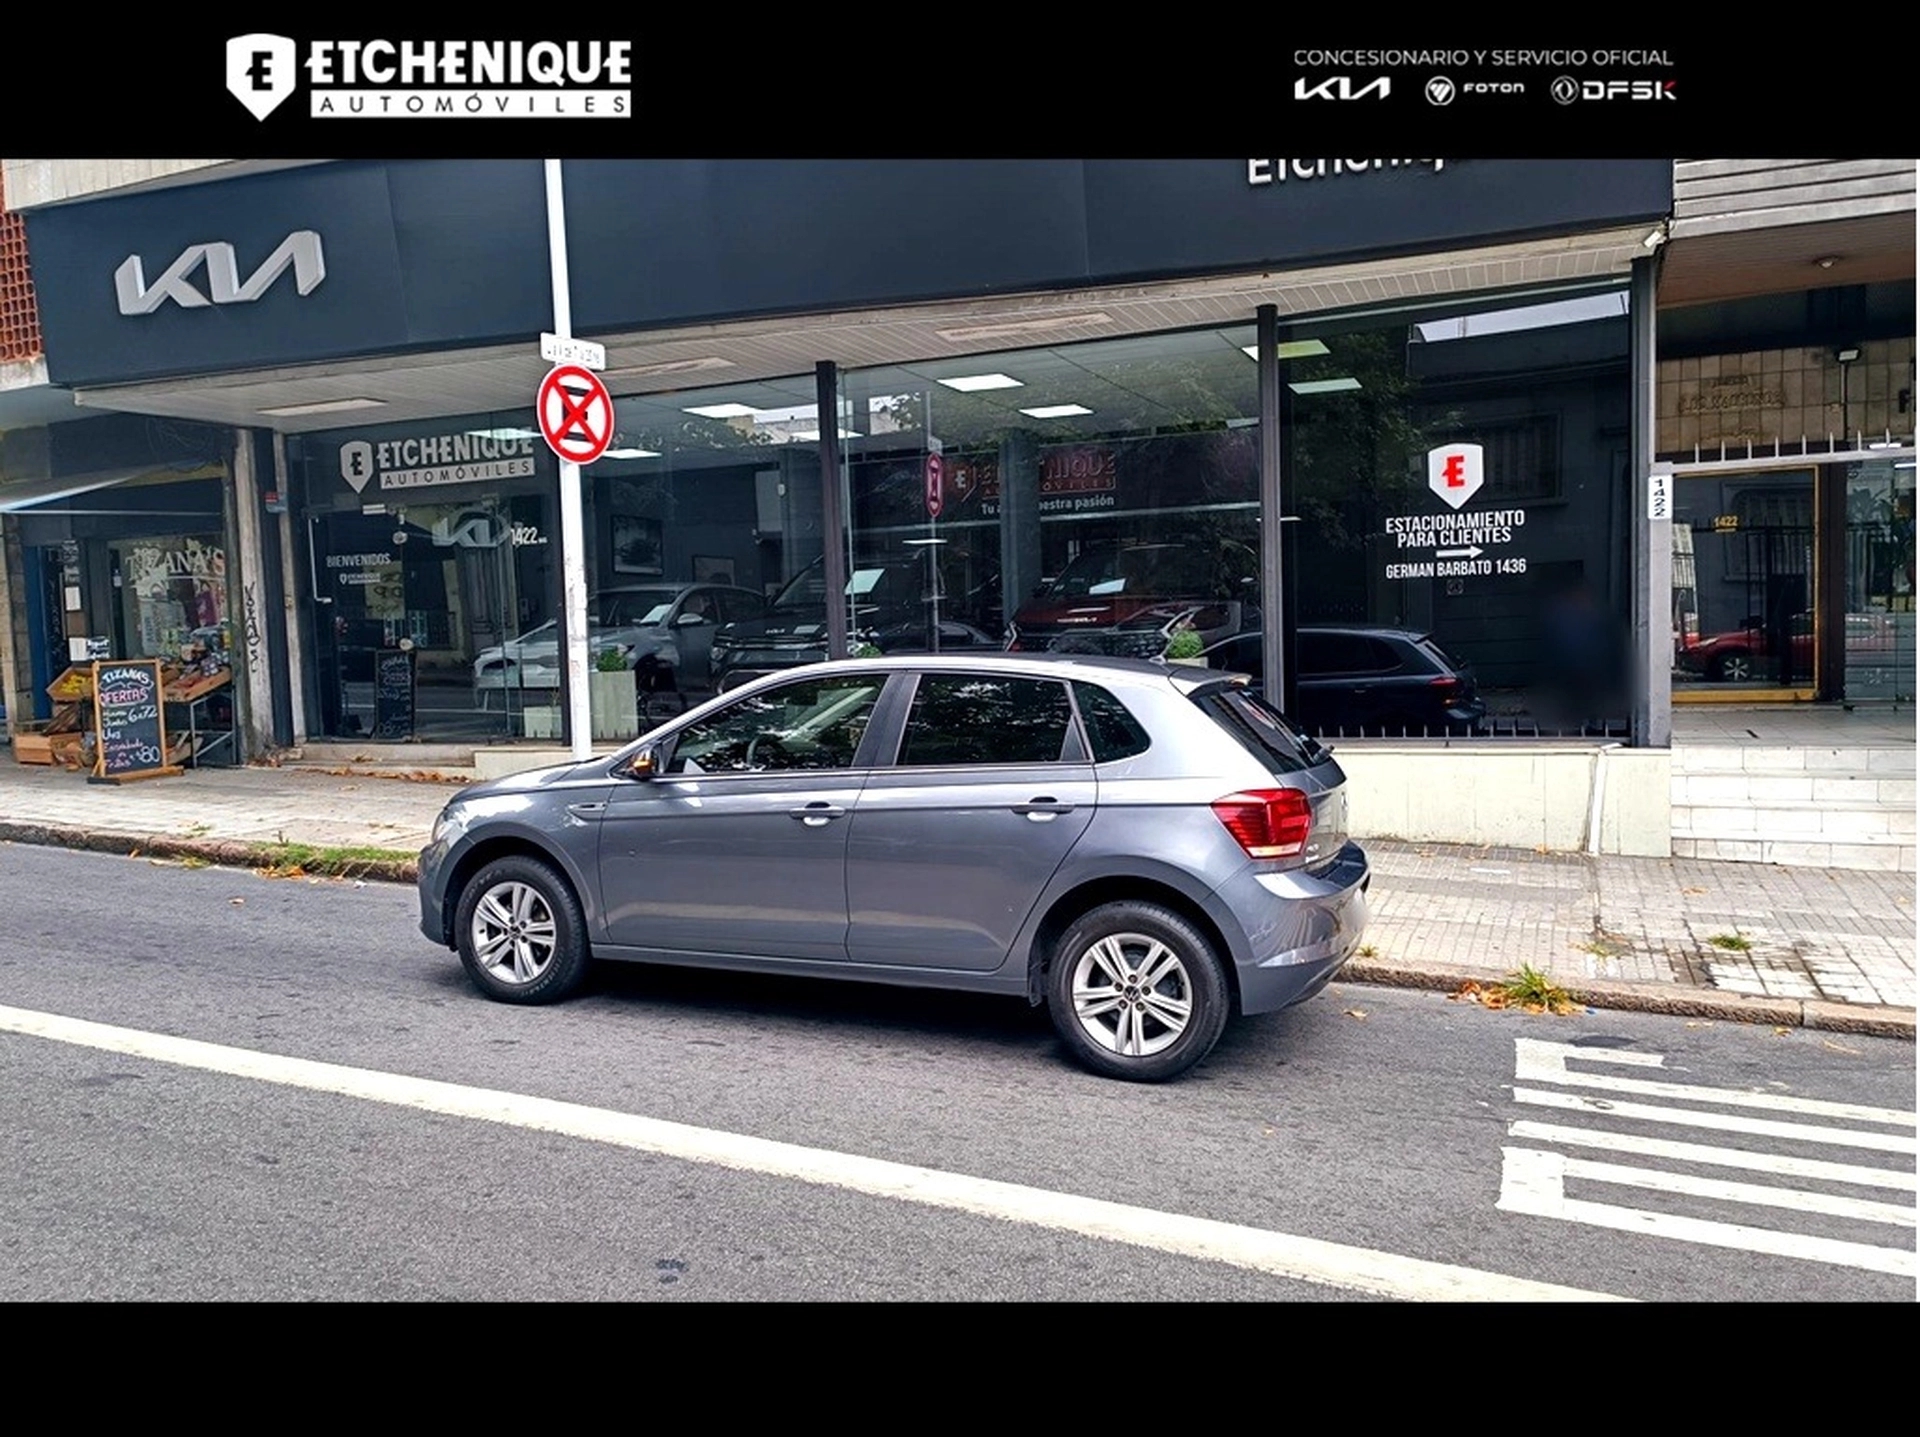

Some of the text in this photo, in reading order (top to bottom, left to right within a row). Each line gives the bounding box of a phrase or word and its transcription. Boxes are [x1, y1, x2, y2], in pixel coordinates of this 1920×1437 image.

[376, 427, 534, 469] ETCHENIQUE
[1442, 455, 1465, 488] E
[981, 503, 996, 516] Tu
[1075, 494, 1115, 512] pasión
[1385, 510, 1525, 534] ESTACIONAMIENTO
[1713, 515, 1738, 527] 1422
[511, 527, 538, 545] 1422
[1397, 526, 1512, 548] PARA CLIENTES
[326, 552, 392, 568] BIENVENIDOS
[1386, 558, 1526, 579] GERMAN BARBATO 1436
[99, 688, 149, 704] OFERTAS
